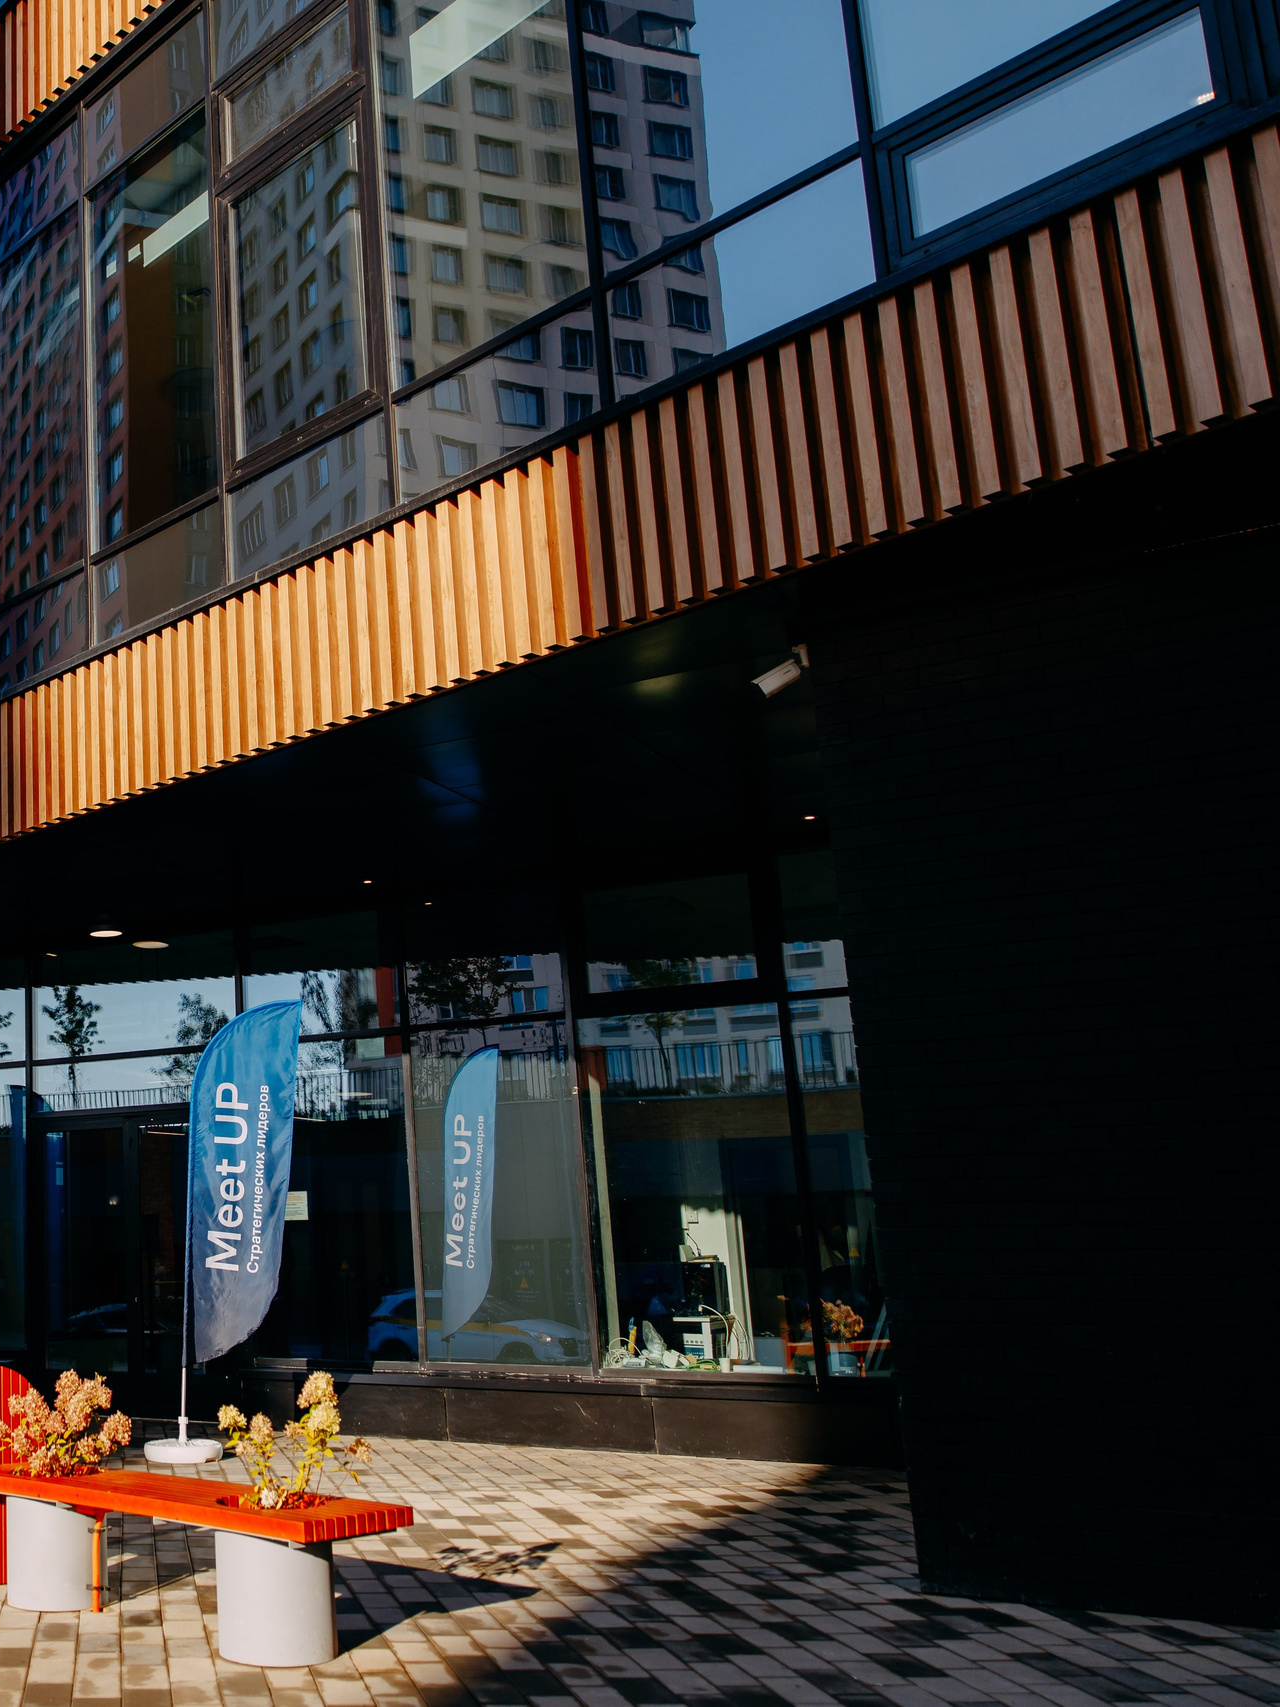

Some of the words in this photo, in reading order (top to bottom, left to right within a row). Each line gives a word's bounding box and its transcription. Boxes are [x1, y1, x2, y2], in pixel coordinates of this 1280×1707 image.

[214, 1082, 249, 1145] UP
[453, 1114, 472, 1165] UP
[205, 1158, 246, 1272] Meet
[246, 1151, 266, 1274] Стратегических
[256, 1085, 271, 1149] лидеров
[445, 1176, 468, 1268] Meet
[466, 1169, 482, 1269] Стратегических
[476, 1115, 485, 1167] лидеров
